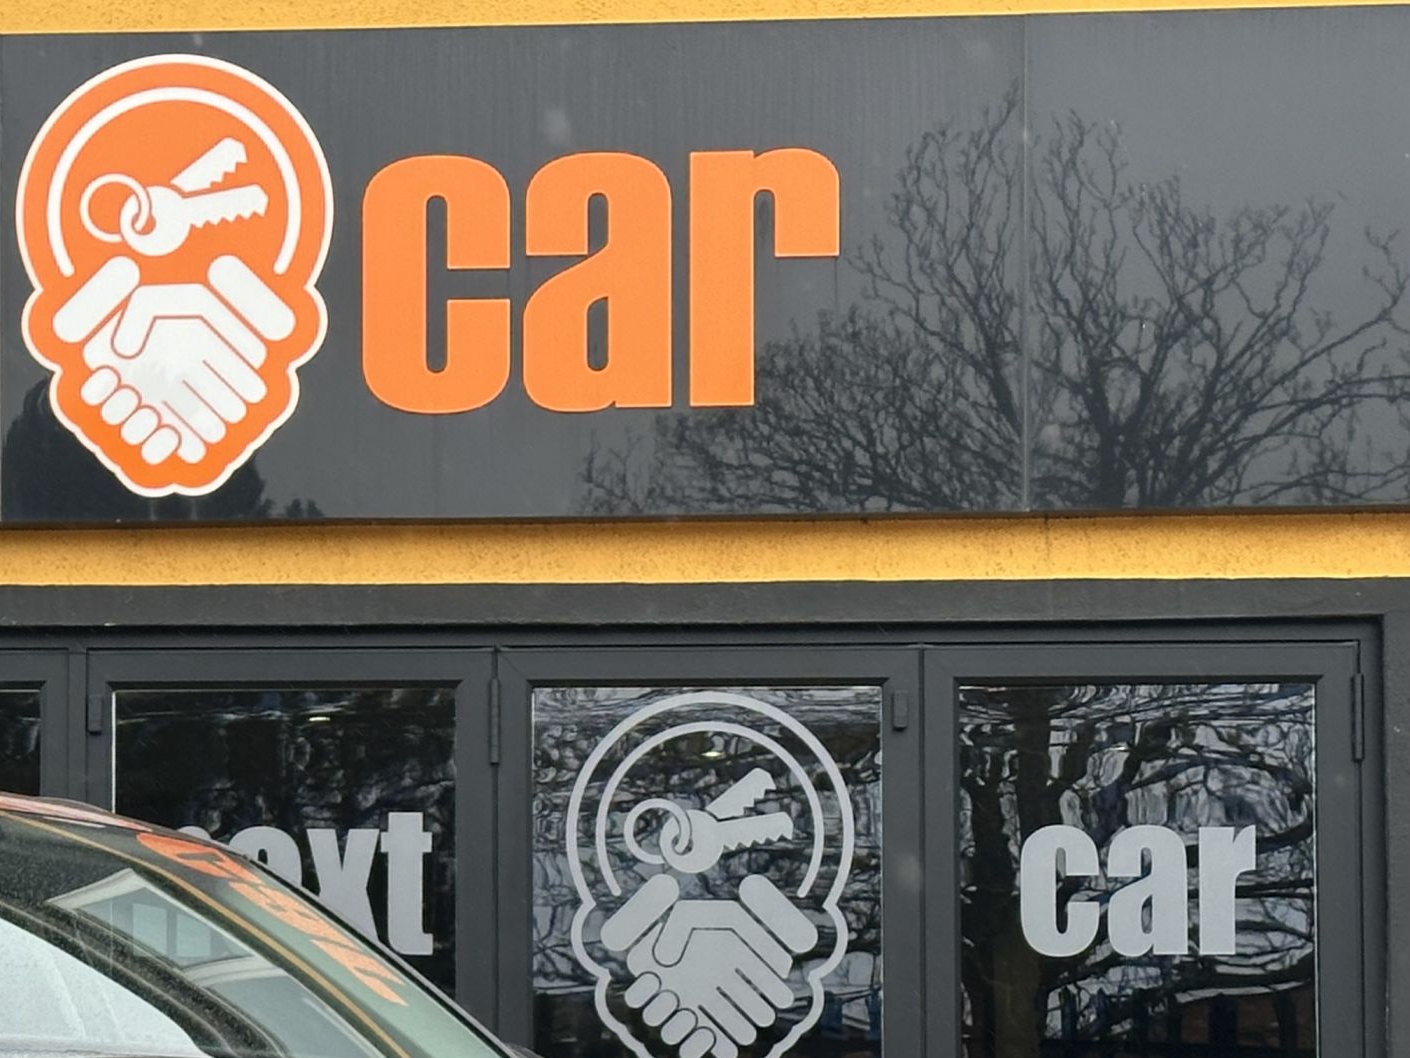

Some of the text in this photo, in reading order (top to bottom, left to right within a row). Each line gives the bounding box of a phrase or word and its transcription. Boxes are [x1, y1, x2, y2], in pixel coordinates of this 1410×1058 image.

[361, 148, 841, 415] car
[178, 811, 435, 956] xt
[1020, 824, 1256, 957] car
